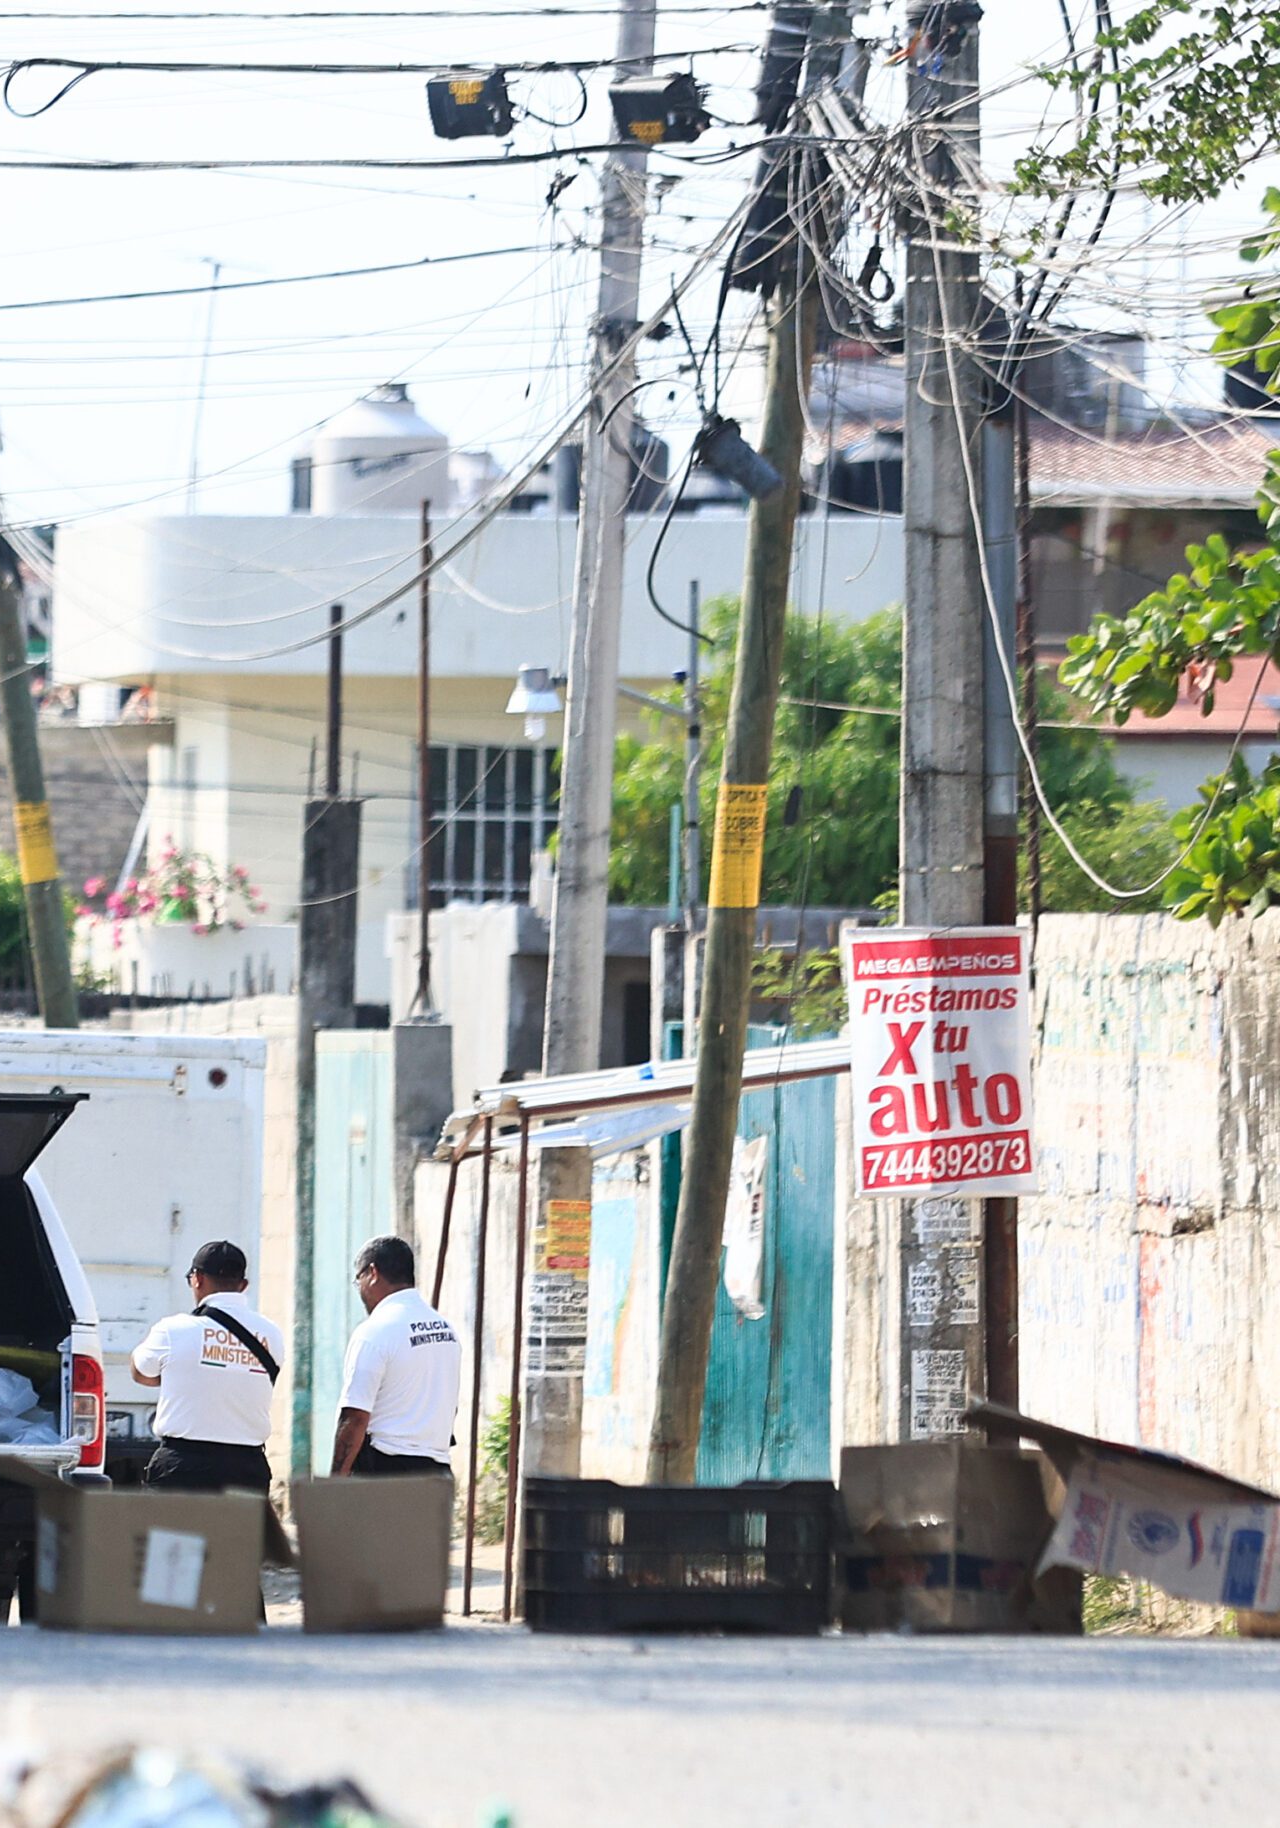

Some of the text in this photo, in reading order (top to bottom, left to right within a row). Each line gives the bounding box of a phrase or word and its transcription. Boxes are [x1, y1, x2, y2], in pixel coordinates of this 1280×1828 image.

[857, 953, 1017, 976] MEGAEMPEÑOS
[862, 985, 1018, 1015] Préstamos
[933, 1020, 970, 1053] tu
[868, 1063, 1022, 1137] auto
[866, 1137, 1026, 1185] 7444392873
